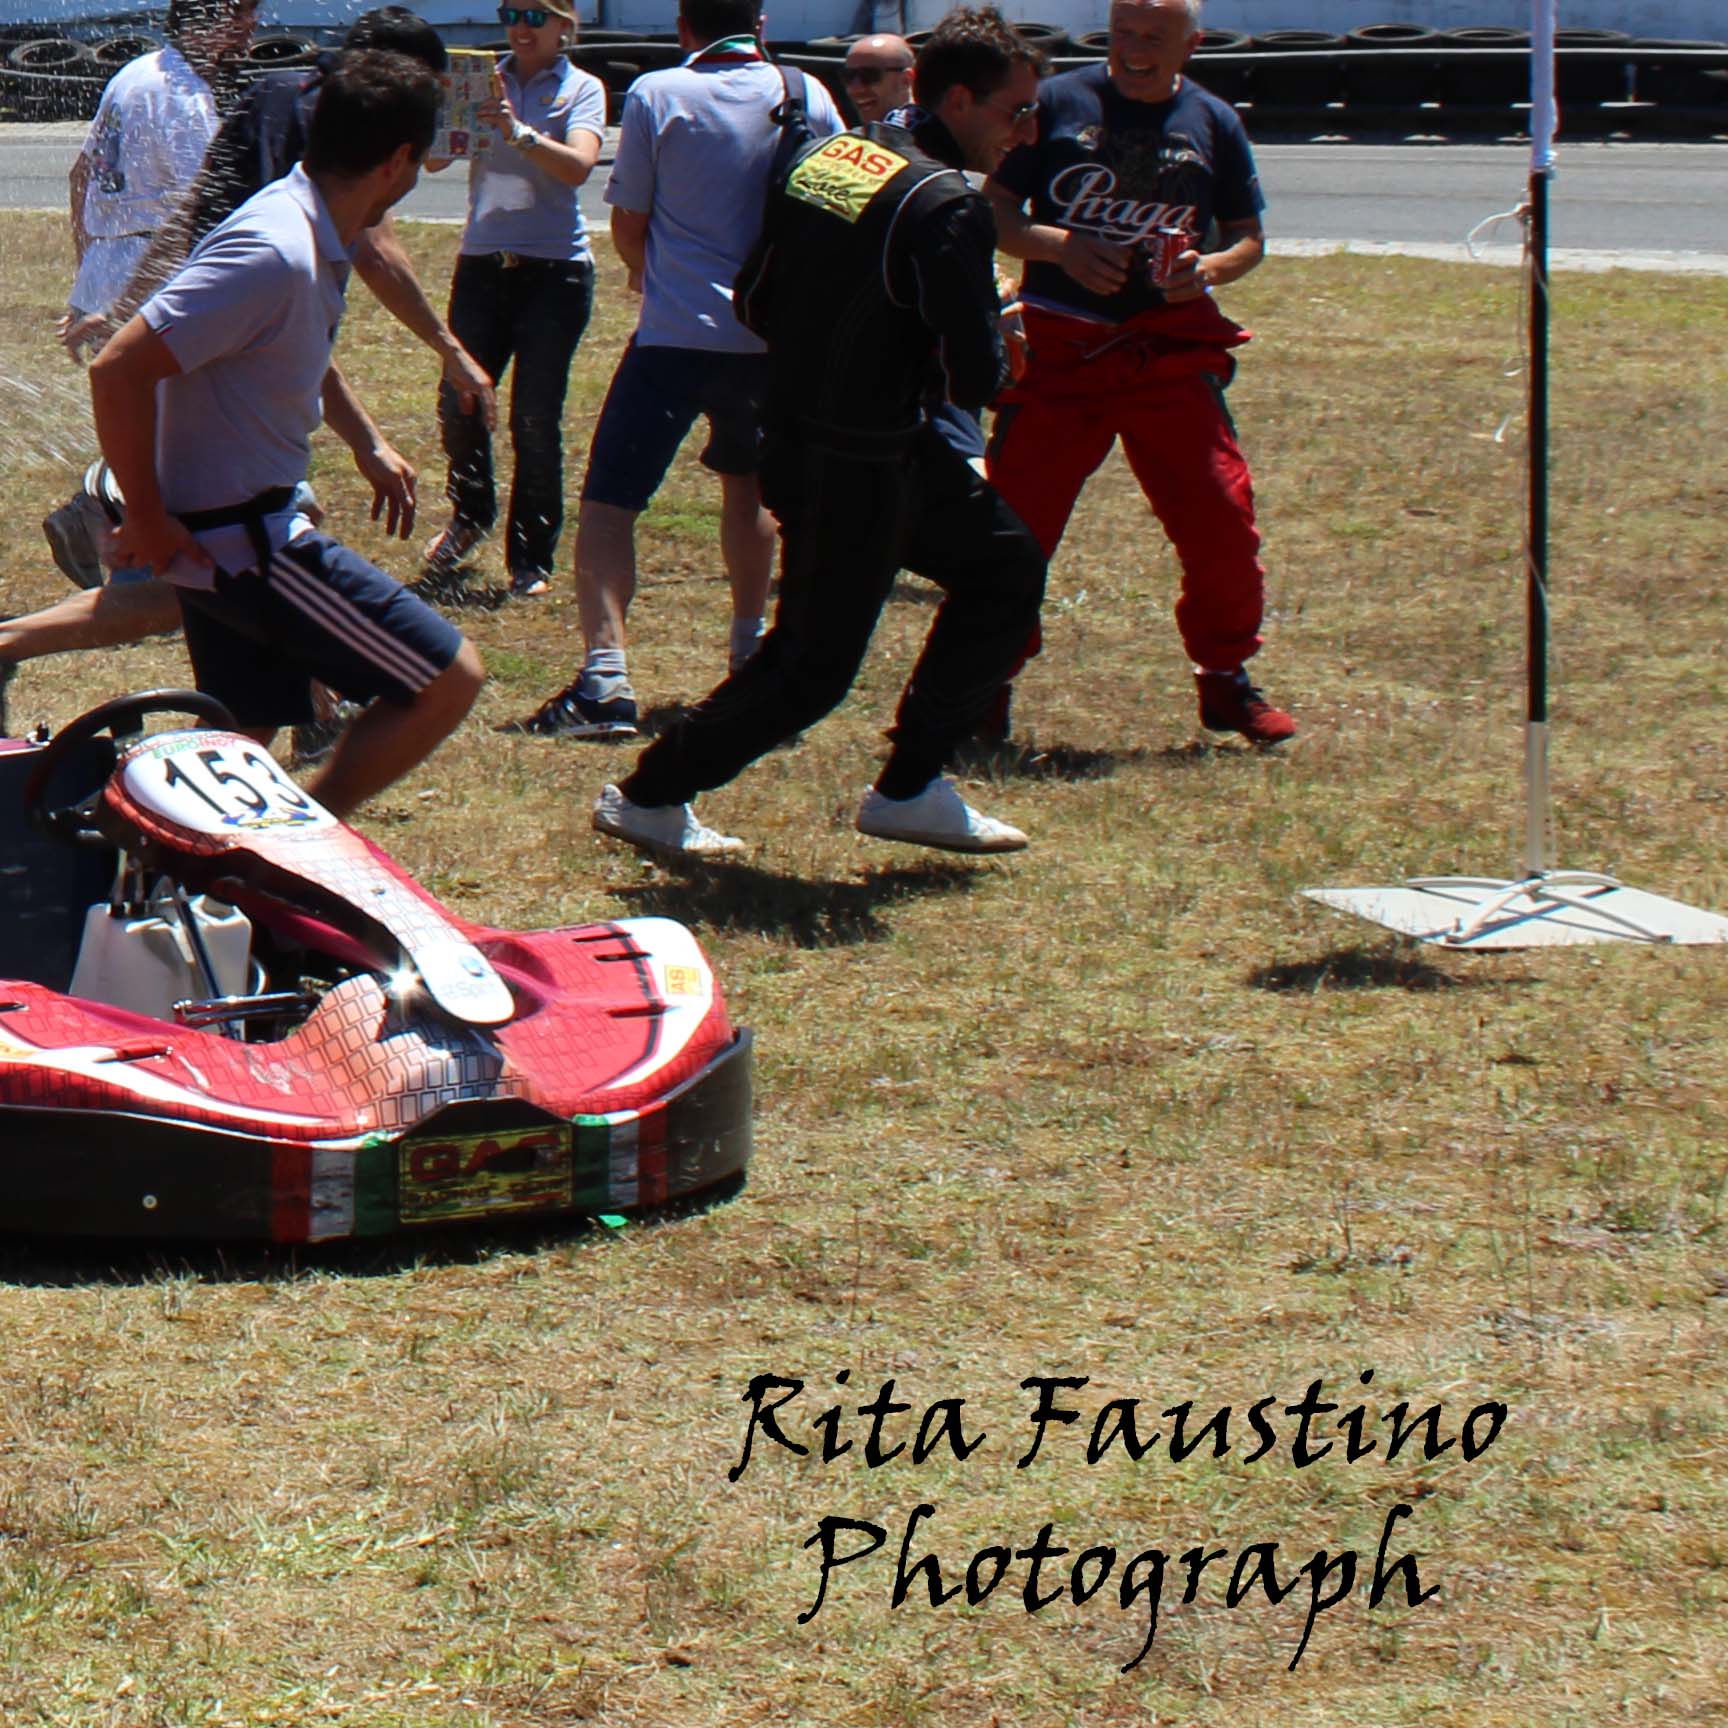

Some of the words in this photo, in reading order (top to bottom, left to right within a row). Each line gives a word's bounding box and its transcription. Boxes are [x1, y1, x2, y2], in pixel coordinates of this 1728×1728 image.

[821, 139, 893, 176] GAS
[1049, 162, 1201, 246] Praga
[164, 749, 310, 815] 153
